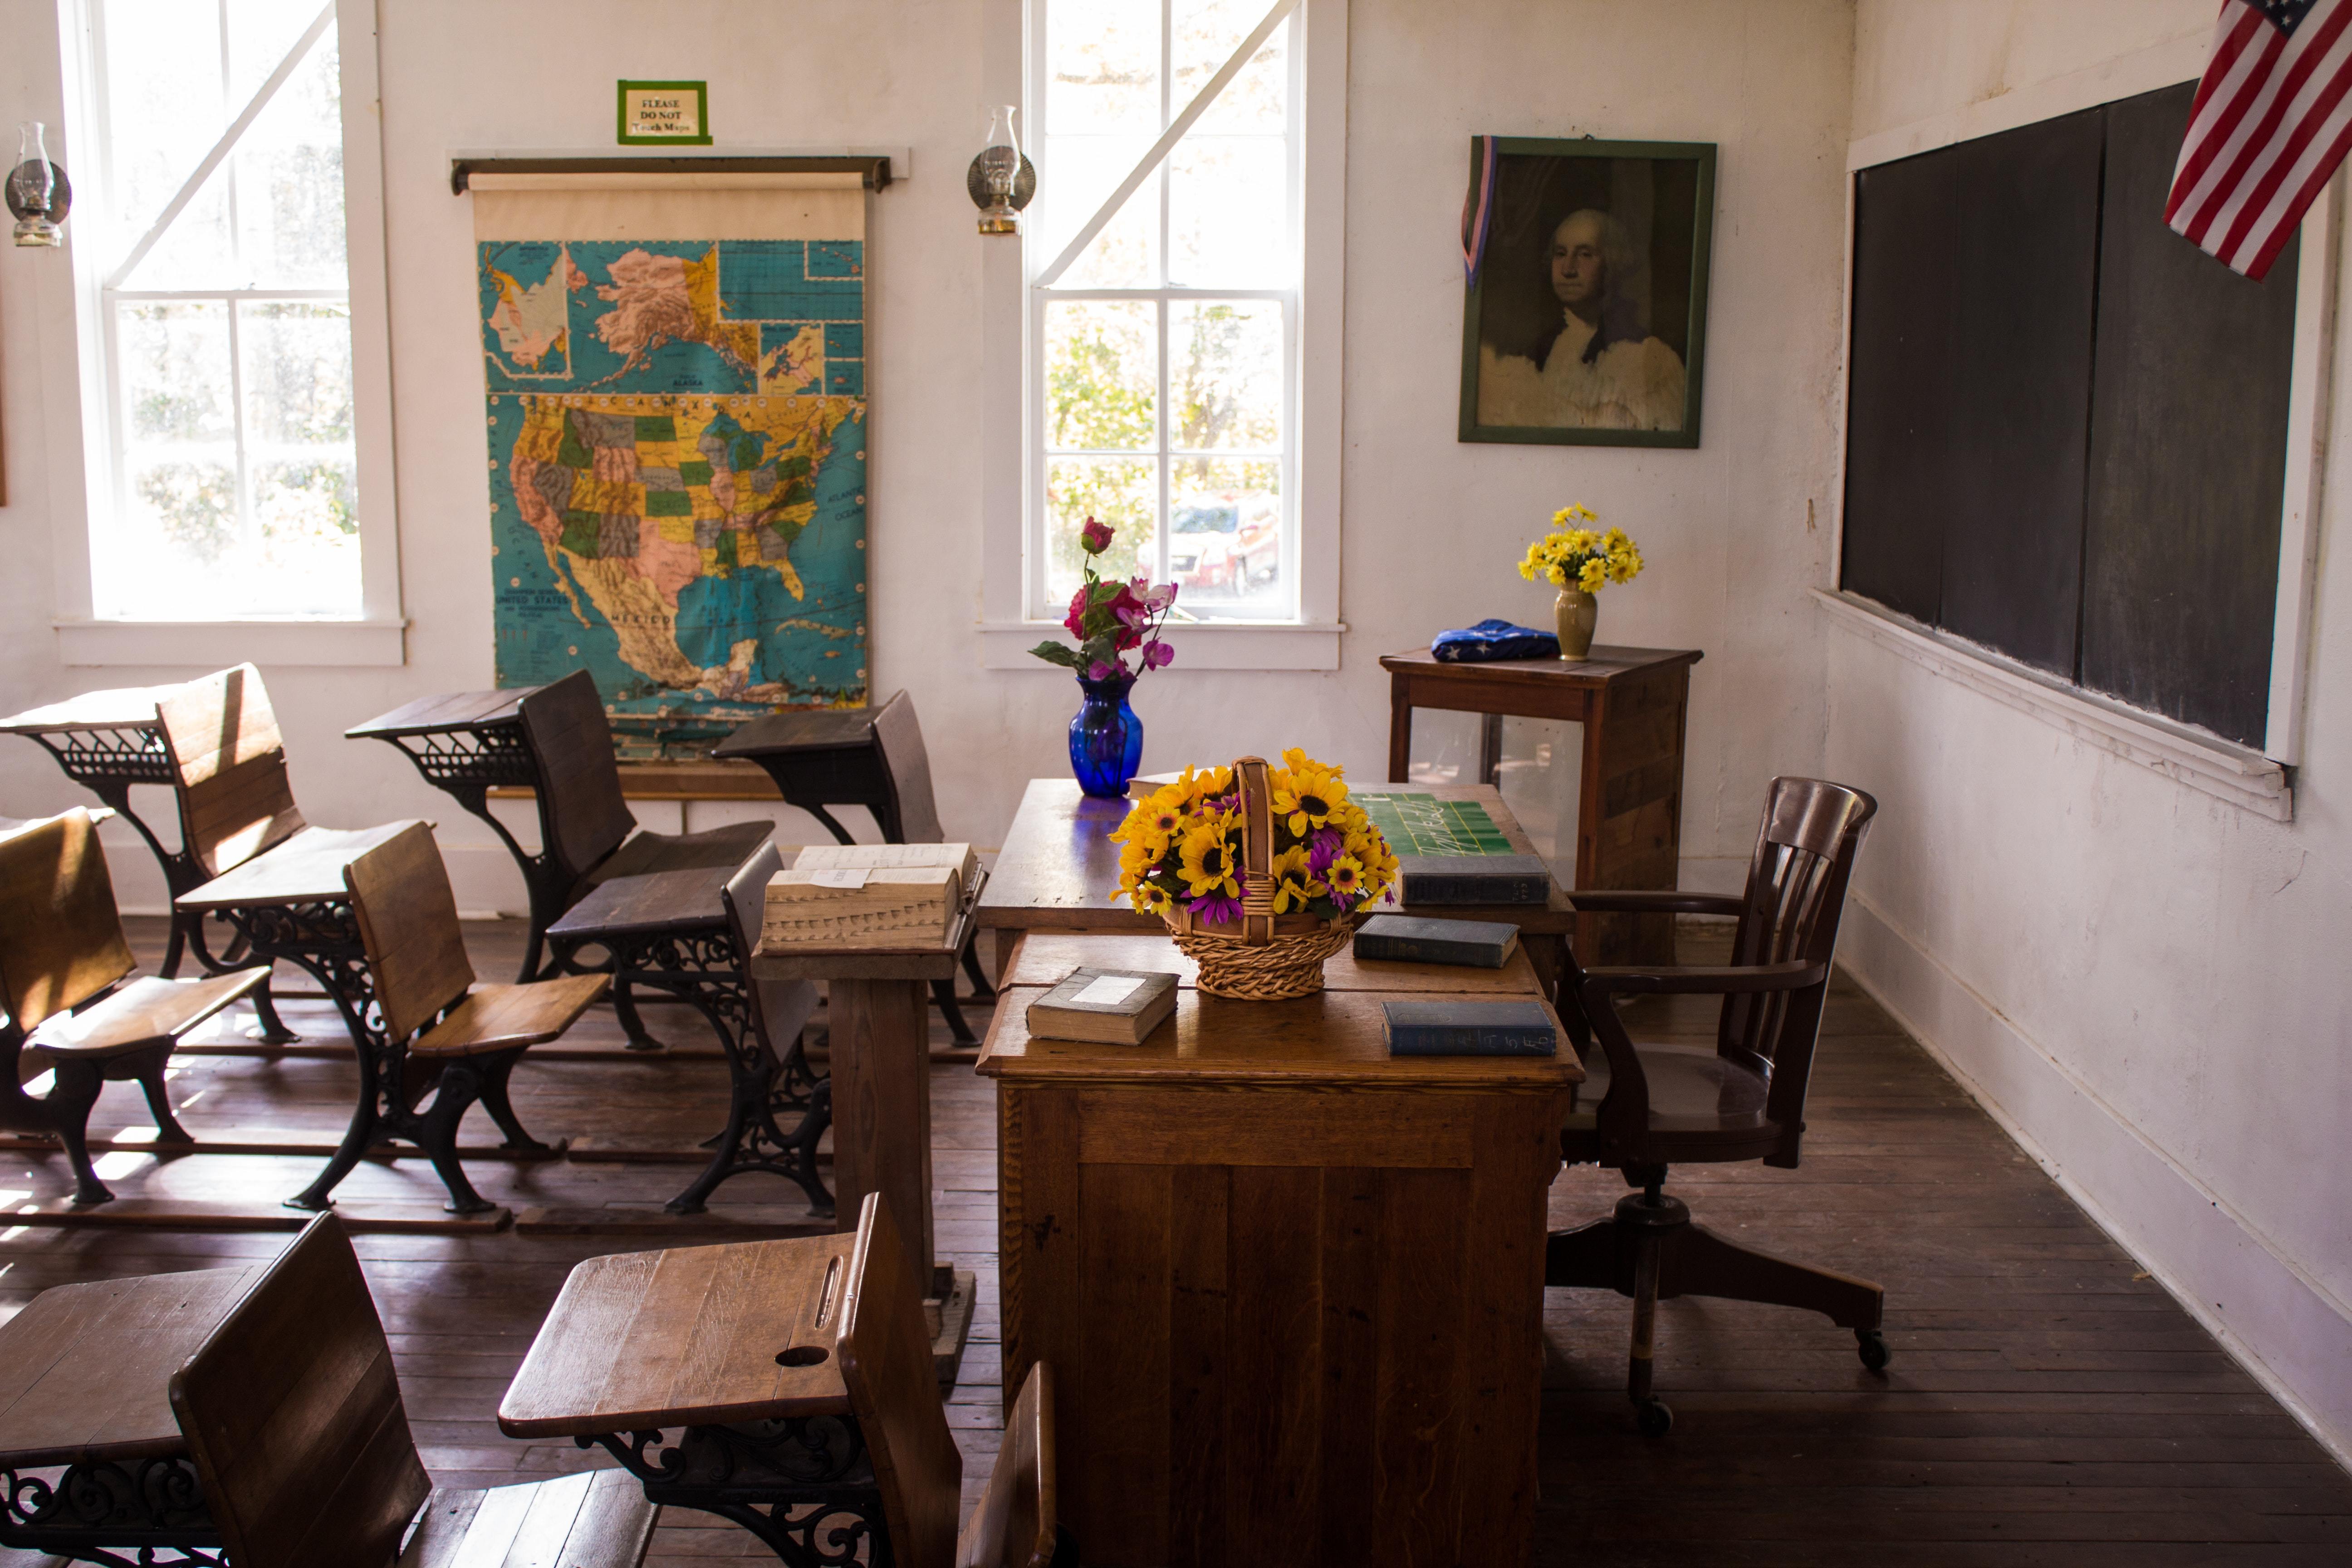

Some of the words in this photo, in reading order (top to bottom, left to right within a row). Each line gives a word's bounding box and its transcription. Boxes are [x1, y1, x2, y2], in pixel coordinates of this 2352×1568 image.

[642, 99, 680, 108] PLEASE
[641, 111, 657, 119] DO
[658, 111, 682, 119] NOT
